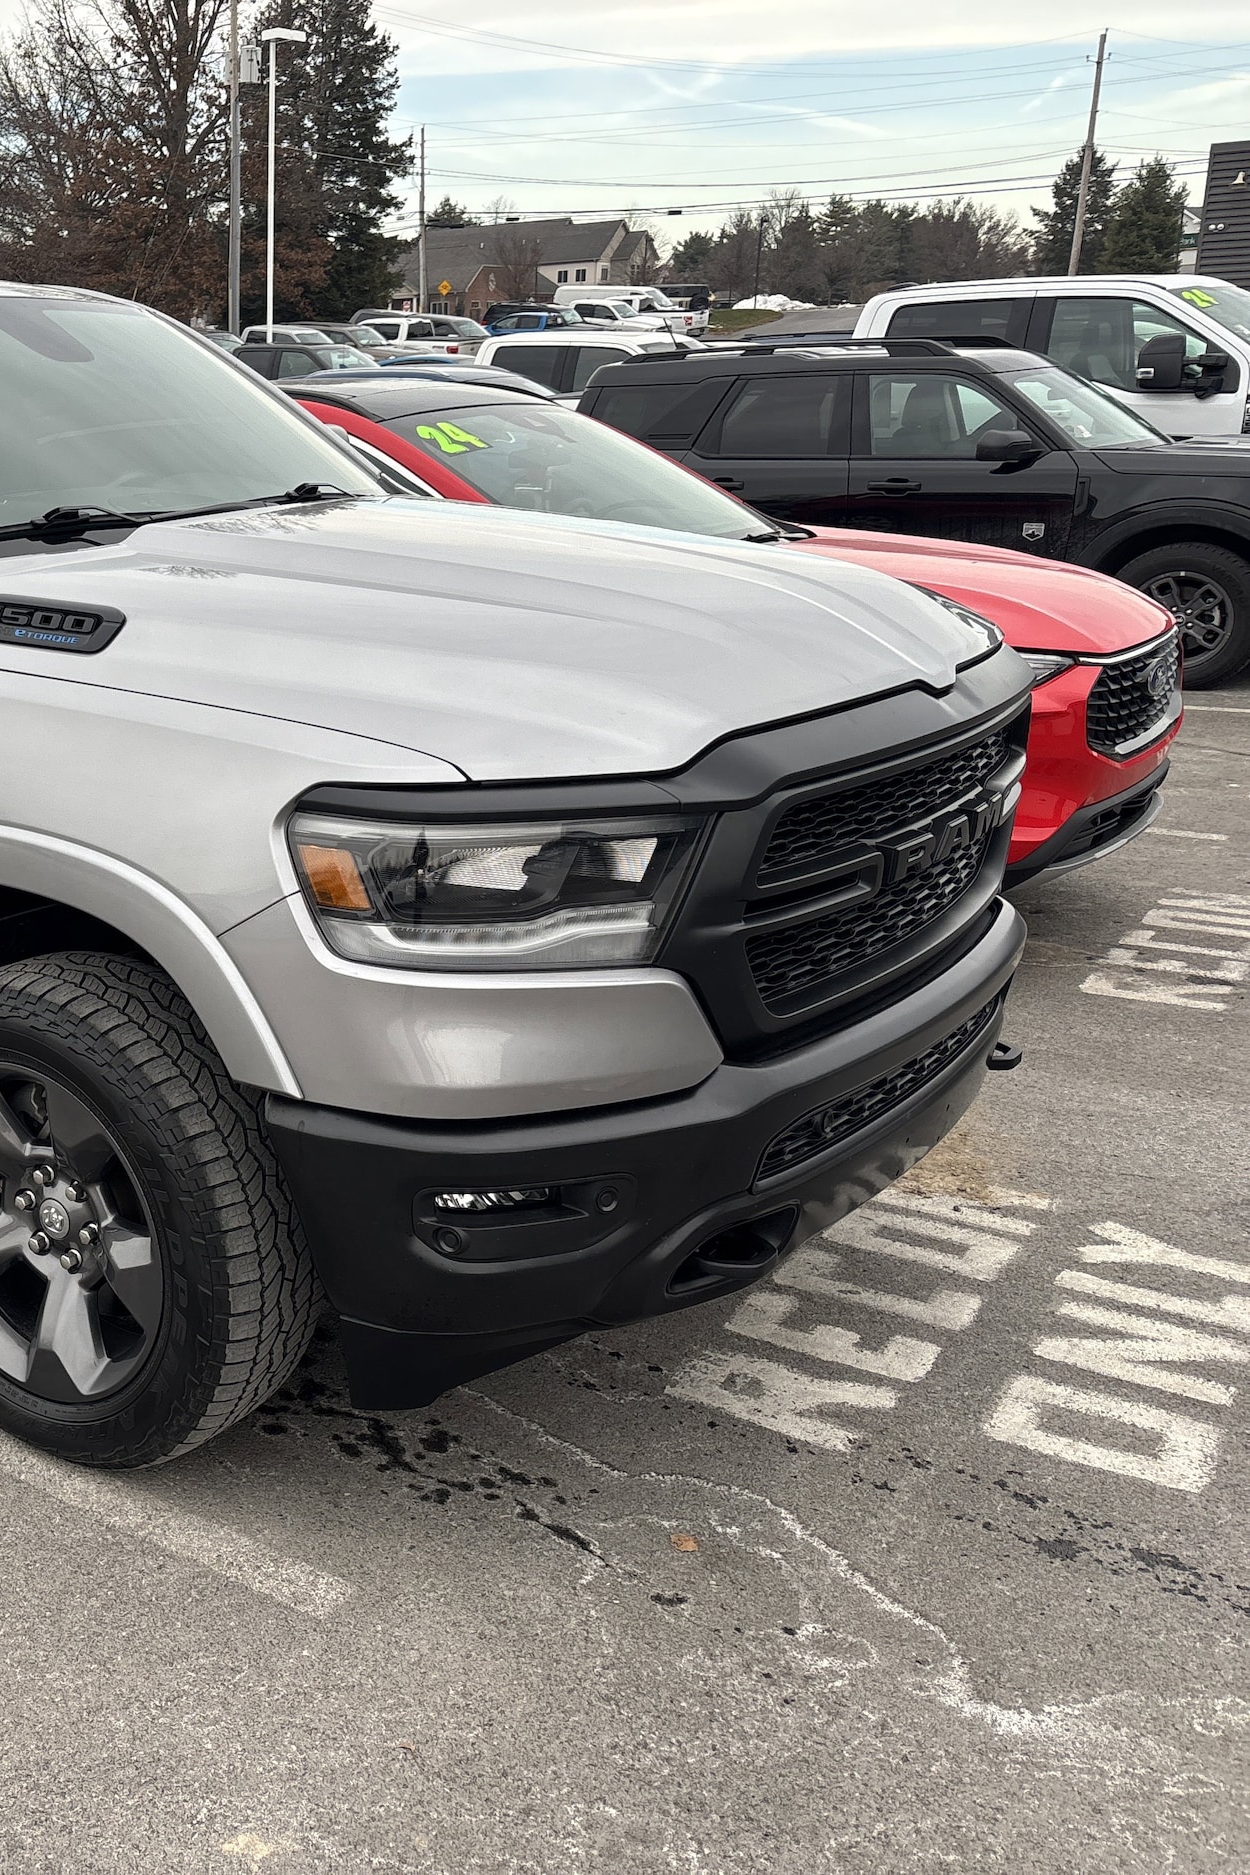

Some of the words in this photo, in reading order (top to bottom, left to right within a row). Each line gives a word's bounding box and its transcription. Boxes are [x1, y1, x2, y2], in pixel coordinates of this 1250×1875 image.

[1182, 289, 1220, 307] 24
[415, 421, 489, 454] 24
[888, 788, 1003, 885] RAM
[981, 1220, 1250, 1494] ONLY
